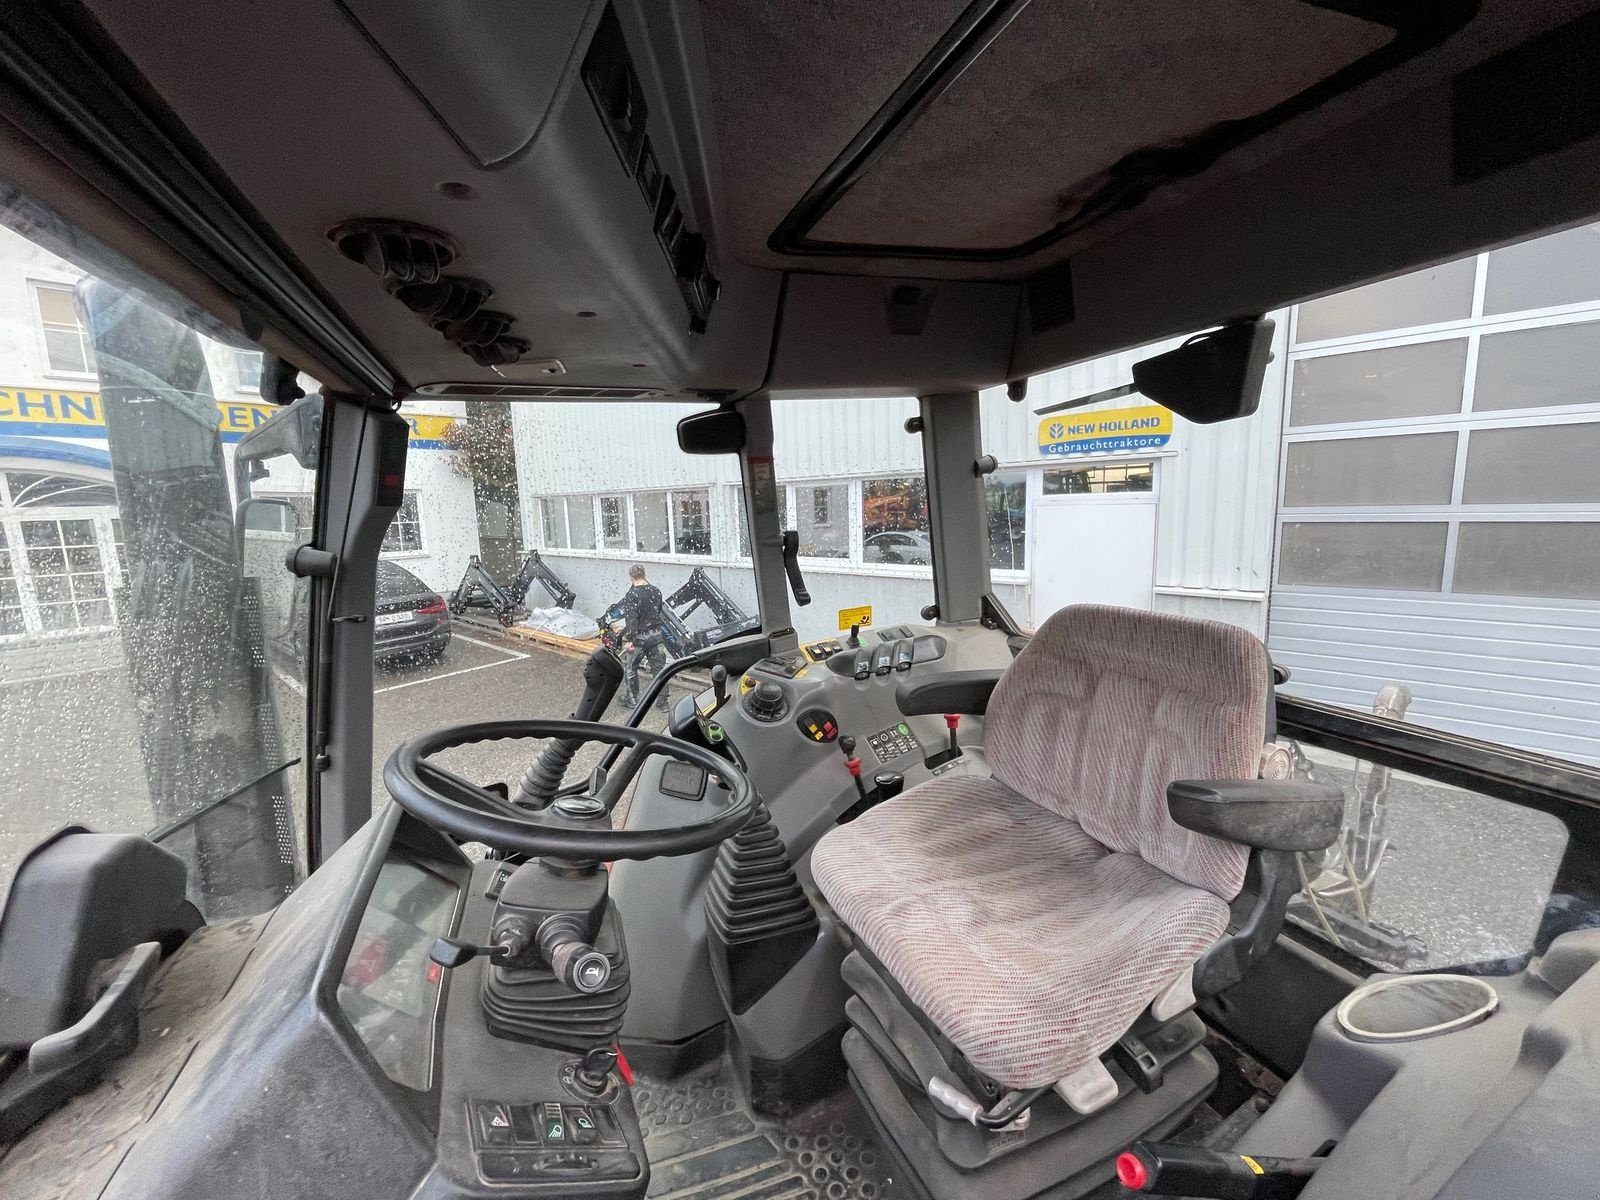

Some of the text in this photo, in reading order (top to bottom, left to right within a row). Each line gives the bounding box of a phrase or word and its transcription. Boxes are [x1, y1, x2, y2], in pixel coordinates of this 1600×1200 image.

[1067, 416, 1161, 436] NEW HOLLAND
[1048, 437, 1161, 454] Gebrauchttraktore
